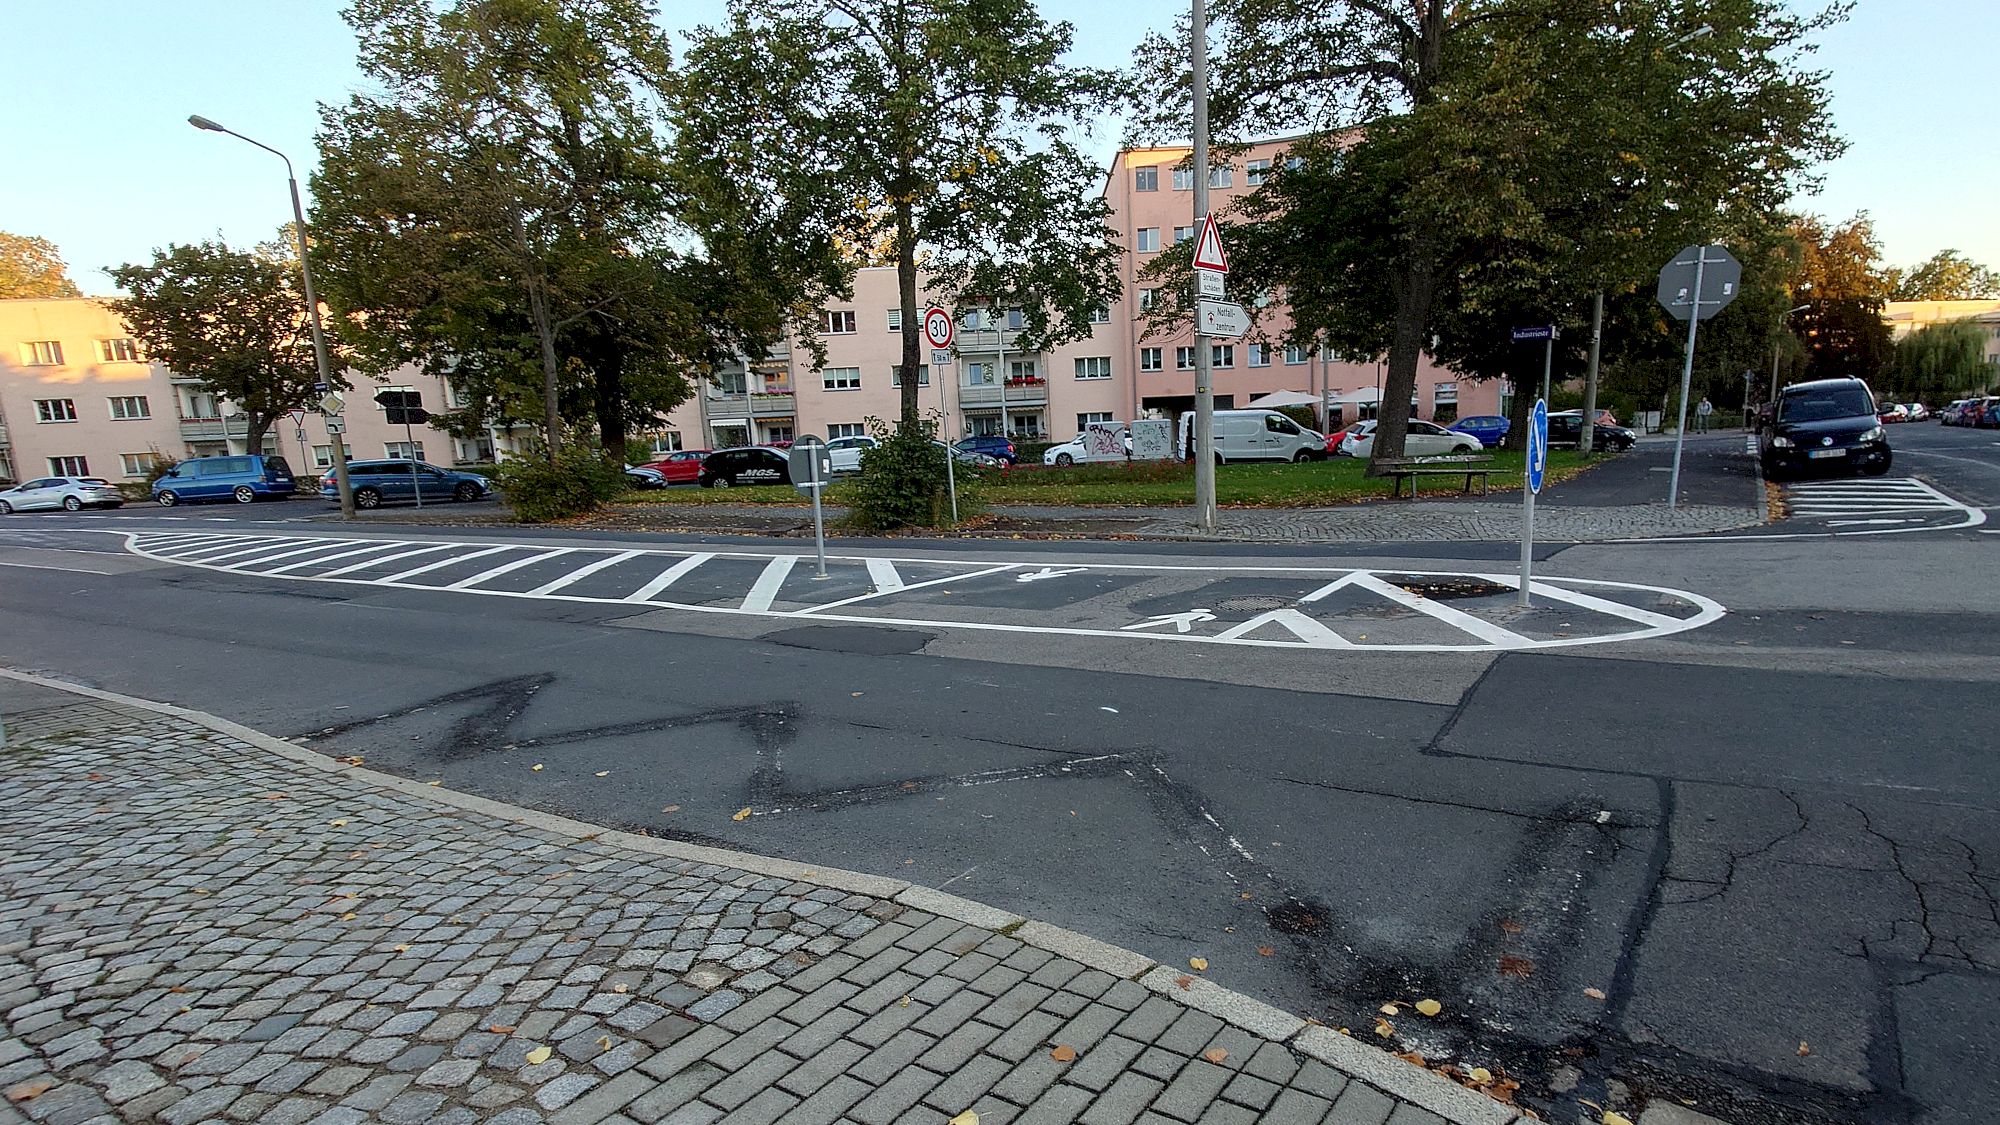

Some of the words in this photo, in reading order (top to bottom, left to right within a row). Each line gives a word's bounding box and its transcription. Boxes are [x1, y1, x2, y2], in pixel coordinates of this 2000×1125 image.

[1202, 273, 1221, 283] Straßen-
[1203, 284, 1221, 292] schäden
[1217, 306, 1236, 318] Notfall-
[930, 319, 947, 338] 30
[1216, 323, 1236, 332] zentrum
[744, 469, 775, 477] MGS
